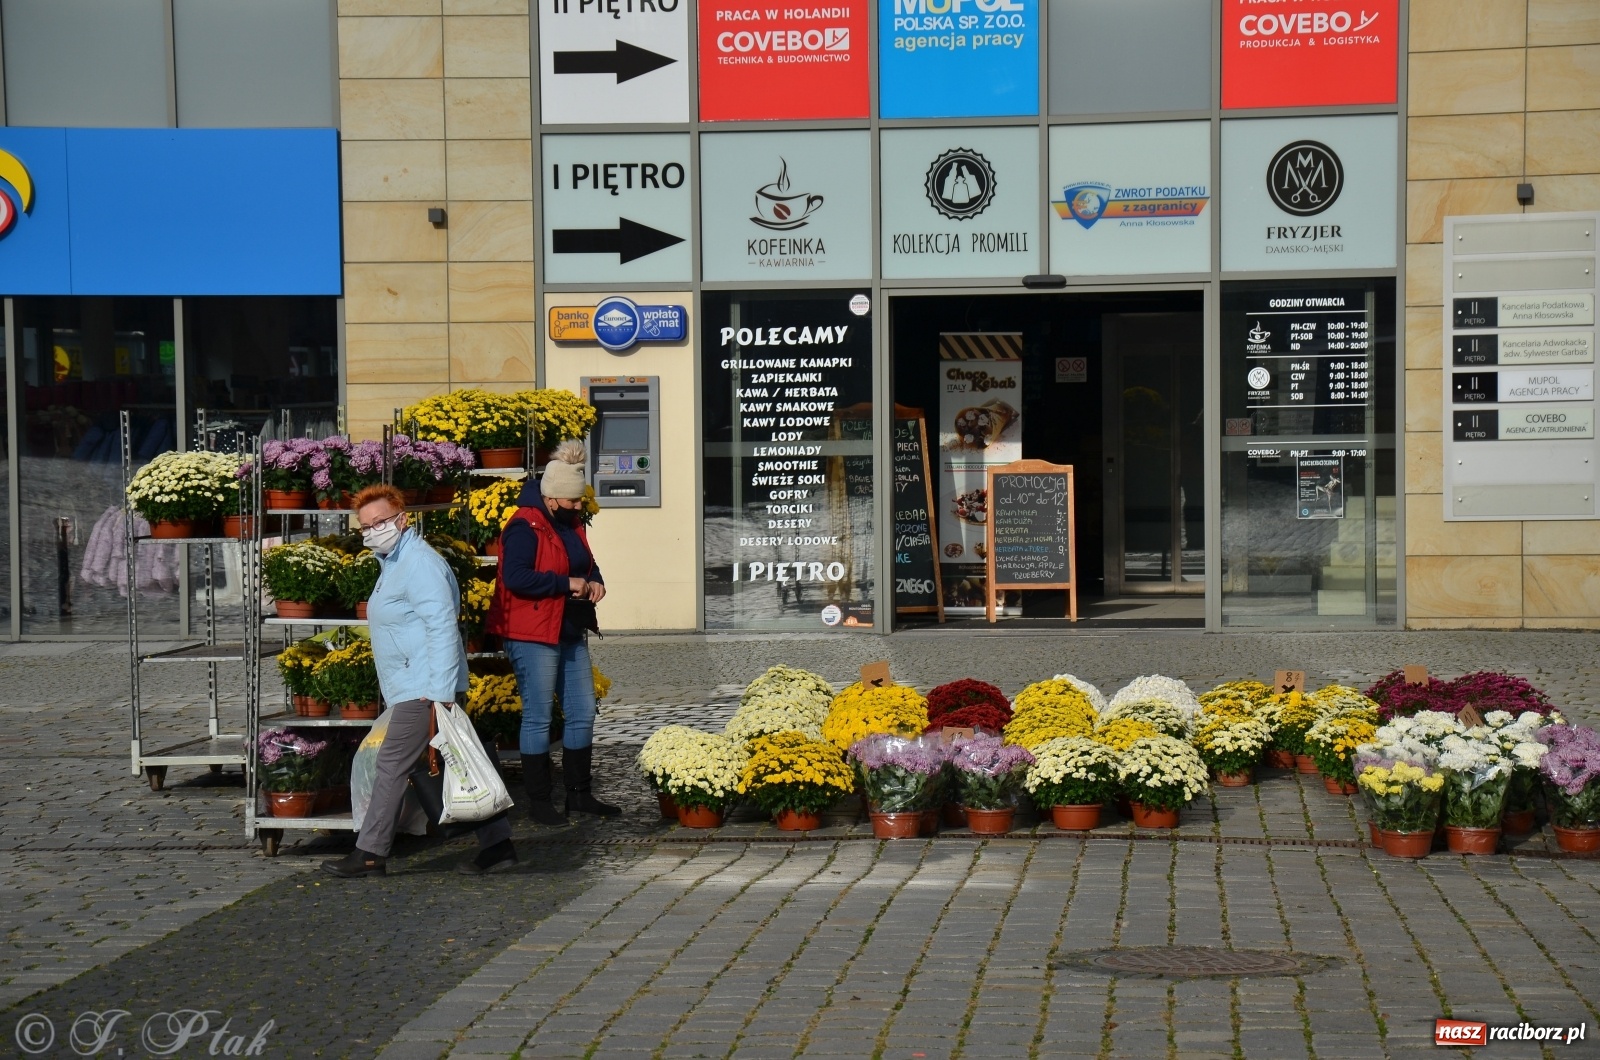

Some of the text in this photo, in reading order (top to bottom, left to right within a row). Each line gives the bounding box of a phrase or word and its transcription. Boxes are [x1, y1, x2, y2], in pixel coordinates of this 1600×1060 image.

[716, 8, 850, 21] PRACA W HOLANDII
[894, 16, 954, 31] POLSKA
[959, 16, 979, 29] SP.
[1240, 11, 1351, 36] COVEBO
[717, 30, 824, 52] COVEBO
[894, 32, 1024, 52] agencja pracy
[1240, 36, 1380, 48] PRODUKCJA & LOGISTYKA
[718, 56, 763, 64] TECHNIKA
[778, 54, 850, 63] BUDOWNICTWO
[554, 162, 684, 196] I PIĘTRO
[1114, 186, 1206, 198] ZWROT PODATKU
[1123, 201, 1197, 214] z zagranicy
[1266, 225, 1342, 241] FRYZJER
[748, 238, 825, 256] KOFEINKA
[894, 232, 1028, 254] KOLEKCJA PROMILI
[1266, 244, 1343, 254] DAMSKO-MĘSKI
[760, 258, 814, 267] KAWIARNIA
[1270, 298, 1345, 307] GODZINY OTWARCIA
[558, 311, 588, 320] banko
[643, 310, 678, 320] wpłato
[1512, 312, 1532, 320] Anna
[659, 319, 678, 327] mat
[1328, 322, 1344, 330] 10:00
[720, 326, 848, 346] POLECAMY
[1328, 332, 1344, 340] 10:00
[1543, 339, 1586, 347] Adwokacka
[1504, 350, 1522, 358] adw.
[1524, 349, 1559, 358] Sylwester
[721, 358, 852, 369] GRILLOWANE KANAPKI
[1291, 361, 1310, 370] PN-ŚR
[752, 372, 822, 383] ZAPIEKANKI
[946, 368, 988, 380] Choco
[969, 377, 1016, 392] Kebab
[736, 388, 768, 398] KAWA
[785, 387, 838, 397] HERBATA
[1509, 388, 1550, 396] AGENCJA
[740, 402, 834, 412] KAWY SMAKOWE
[743, 416, 830, 427] KAWY LODOWE
[1526, 414, 1566, 423] COVEBO
[772, 432, 803, 441] LODY
[754, 446, 821, 456] LEMONIADY
[758, 460, 818, 471] SMOOTHIE
[752, 473, 825, 486] ŚWIEŻE SOKI
[998, 476, 1066, 493] PROMOCJA
[770, 490, 808, 500] GOFRY
[766, 504, 812, 514] TORCIKI
[768, 519, 812, 529] DESERY
[740, 536, 838, 546] DESERY LODOWE
[733, 562, 844, 586] I PIĘTRO
[896, 578, 935, 594] ZNEGO
